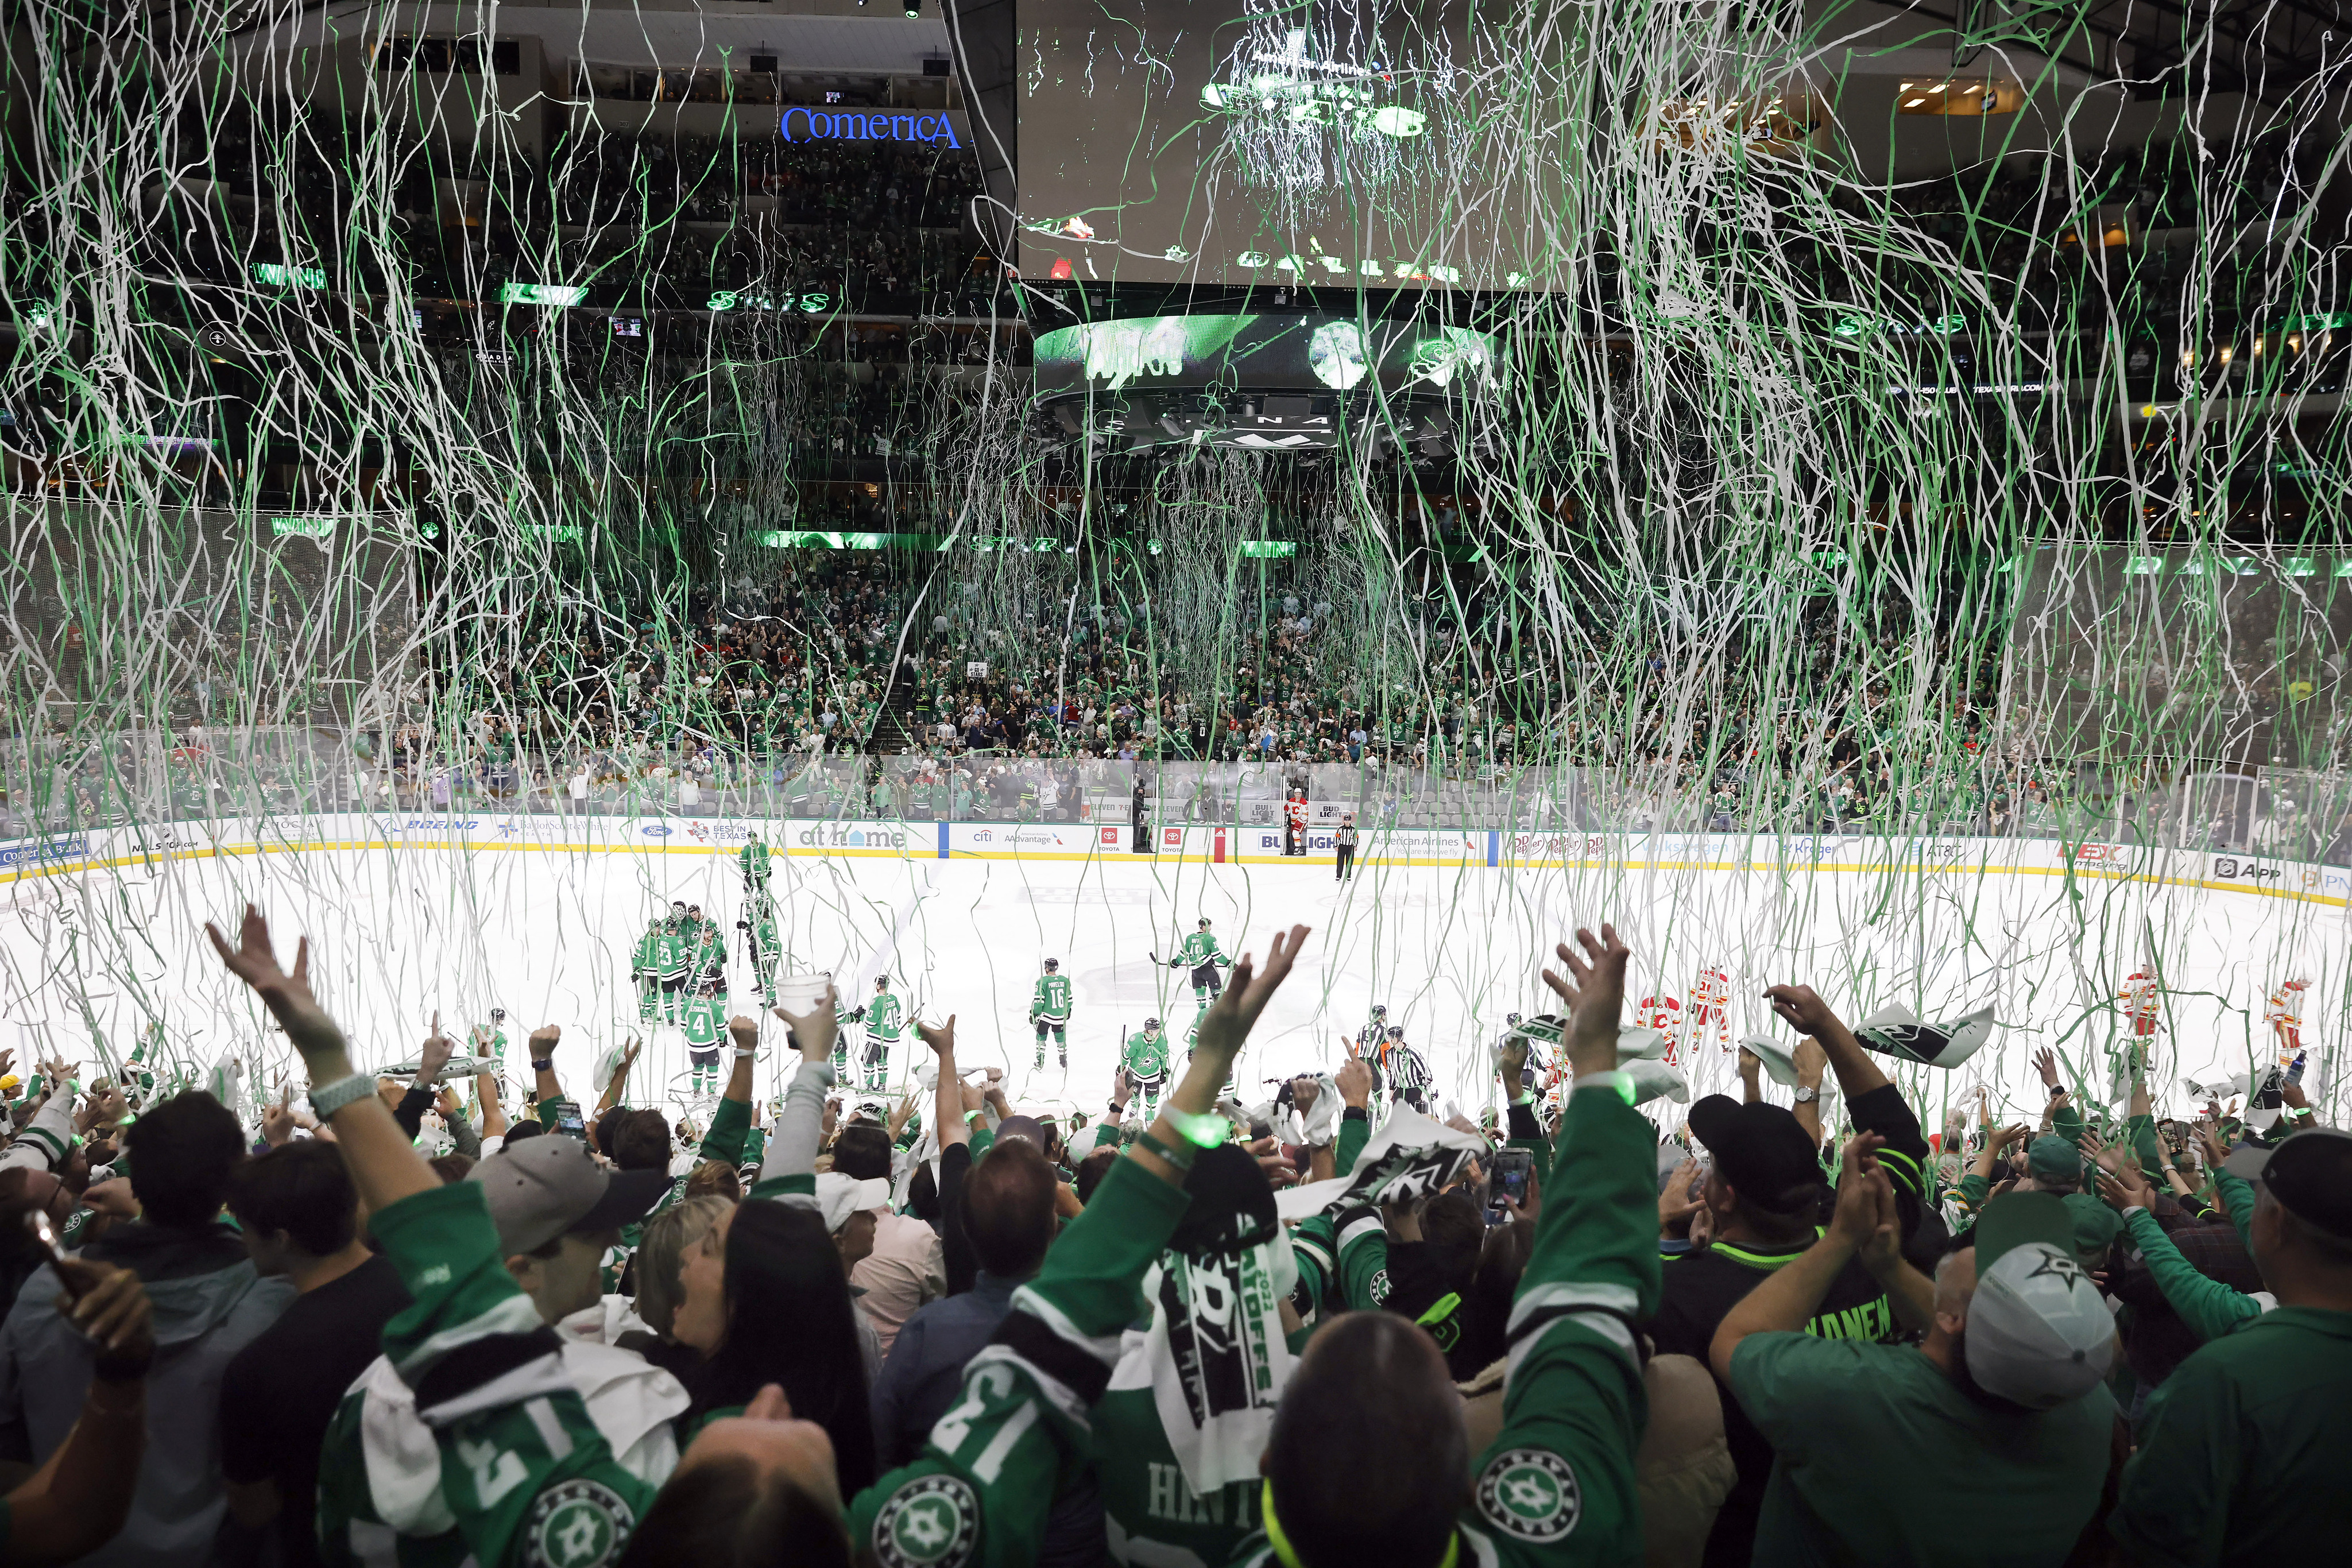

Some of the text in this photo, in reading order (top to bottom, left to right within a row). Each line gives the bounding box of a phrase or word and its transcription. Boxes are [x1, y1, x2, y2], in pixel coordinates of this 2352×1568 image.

[1973, 384, 2043, 393] TEXASORD.COM
[645, 825, 669, 836] Ford
[799, 825, 825, 846] at
[974, 830, 992, 842] citi
[1004, 835, 1051, 845] AAdvantage
[1262, 835, 1281, 848] BU
[1307, 837, 1336, 849] IGH
[1421, 837, 1459, 846] Airlines
[1514, 838, 1542, 854] Peper
[1449, 847, 1458, 857] fly
[2059, 843, 2121, 860] EX
[2073, 860, 2127, 870] maging
[1050, 988, 1065, 1009] 16
[688, 1005, 712, 1013] EISKANE
[693, 1014, 705, 1035] 4
[883, 1007, 899, 1030] 40
[1256, 1268, 1274, 1313] 2022
[1148, 1462, 1261, 1530] HINT
